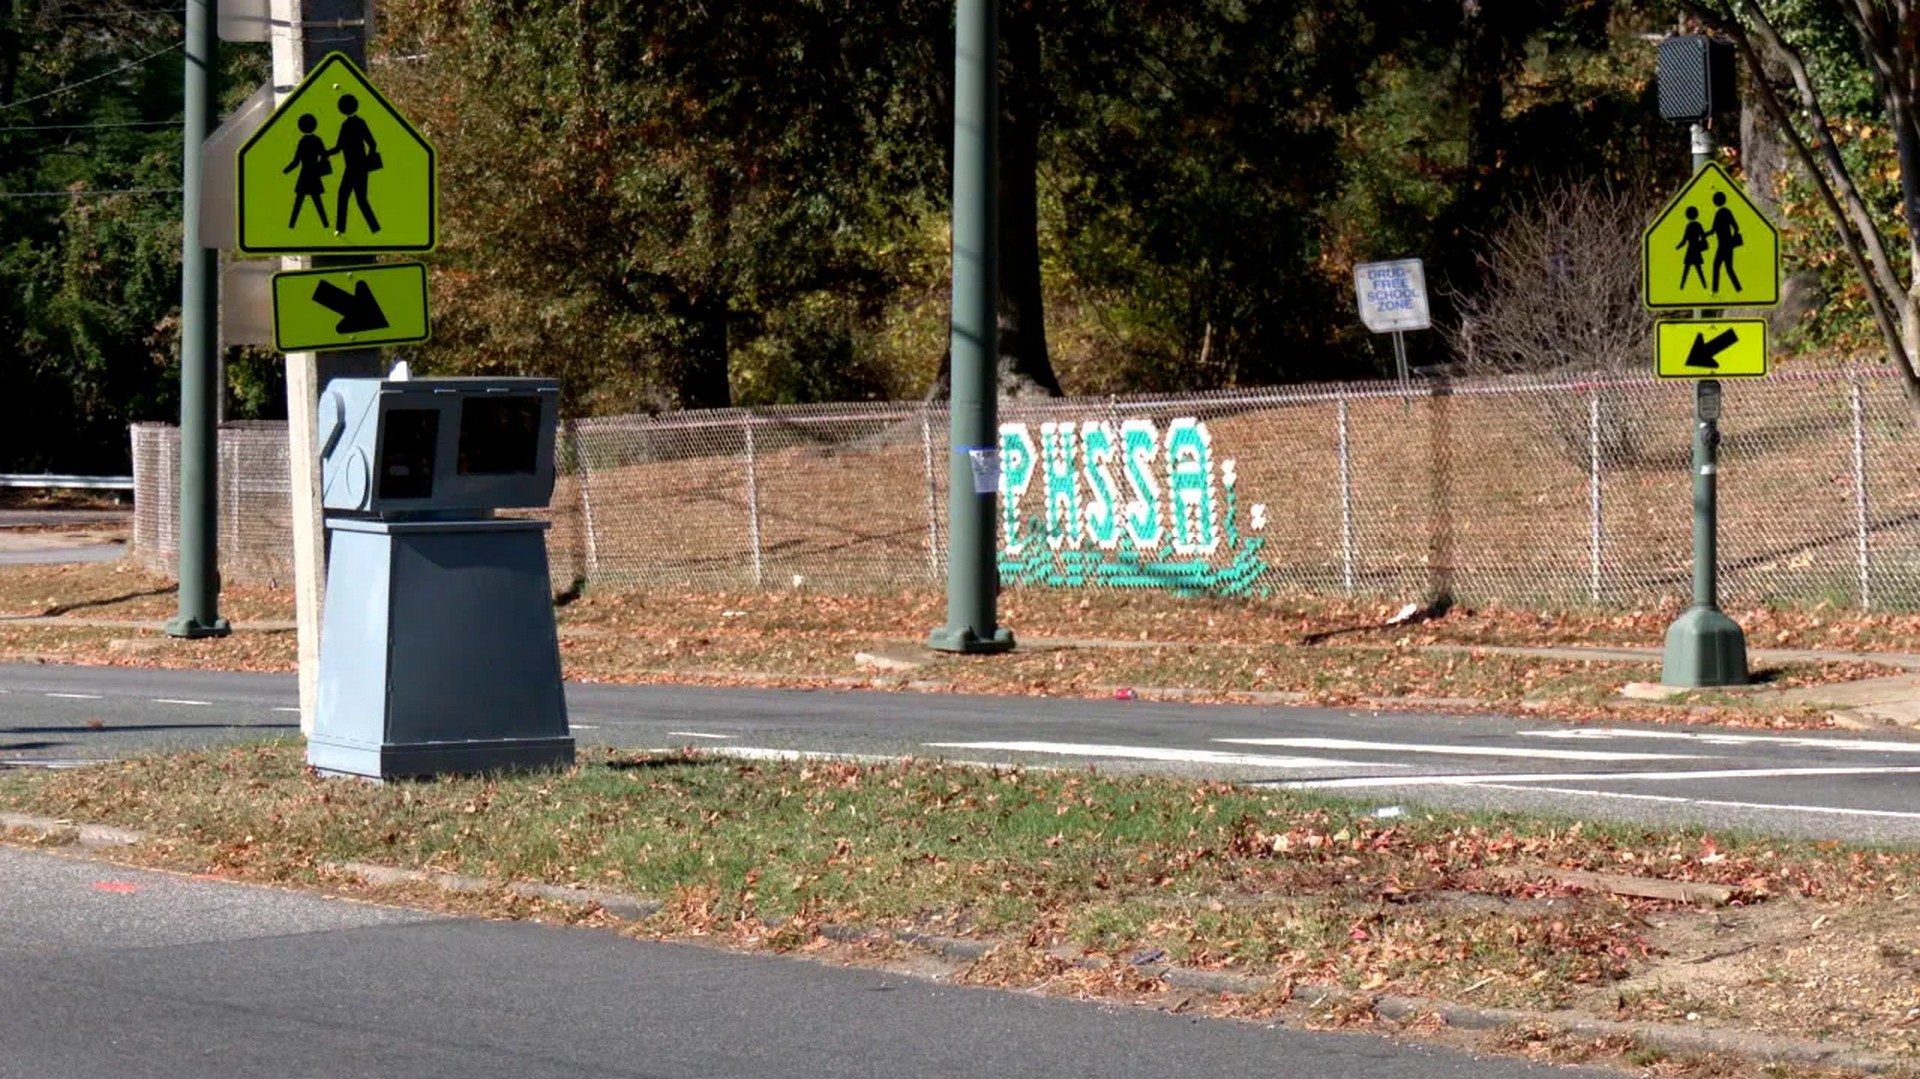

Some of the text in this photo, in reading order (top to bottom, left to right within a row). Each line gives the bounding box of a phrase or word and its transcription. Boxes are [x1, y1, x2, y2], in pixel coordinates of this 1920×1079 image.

[1373, 278, 1408, 290] FREE
[1367, 288, 1419, 302] SCHOOL
[1377, 298, 1415, 312] ZONE
